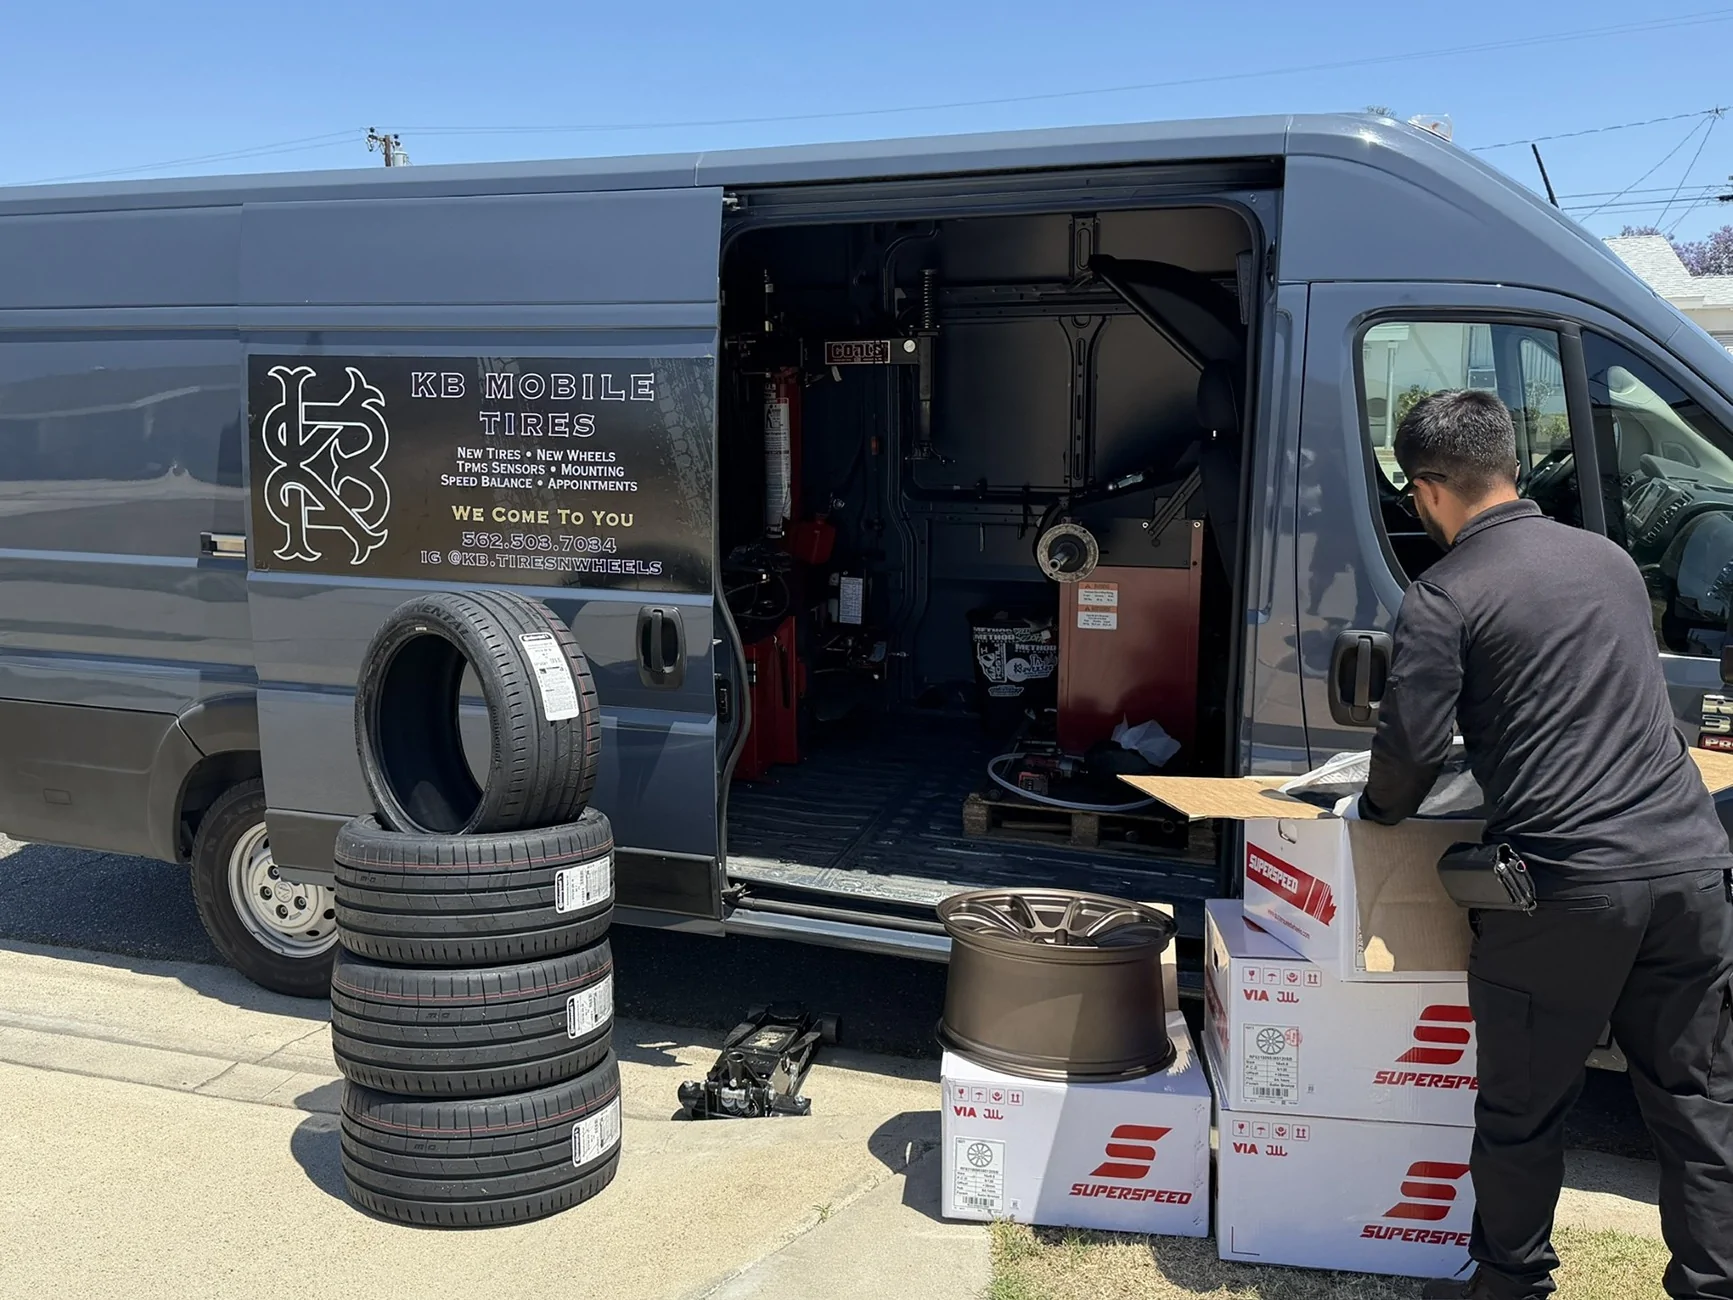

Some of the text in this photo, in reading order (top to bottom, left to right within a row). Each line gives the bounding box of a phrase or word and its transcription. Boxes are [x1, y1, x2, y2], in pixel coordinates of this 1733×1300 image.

[411, 372, 656, 402] KB MOBILE
[480, 411, 597, 438] TIRES
[462, 531, 617, 553] 562.503.7034
[421, 550, 663, 575] IG @KB.TIRESNWHEELS
[1705, 737, 1733, 748] PR
[1249, 853, 1299, 894] SUPERSPEED
[1243, 988, 1270, 1002] VIA
[1373, 1070, 1479, 1092] SUPERSPE
[953, 1105, 977, 1119] VIA
[1232, 1141, 1259, 1156] VIA
[1069, 1182, 1193, 1206] SUPERSPEED
[1360, 1224, 1472, 1249] SUPERSPE
